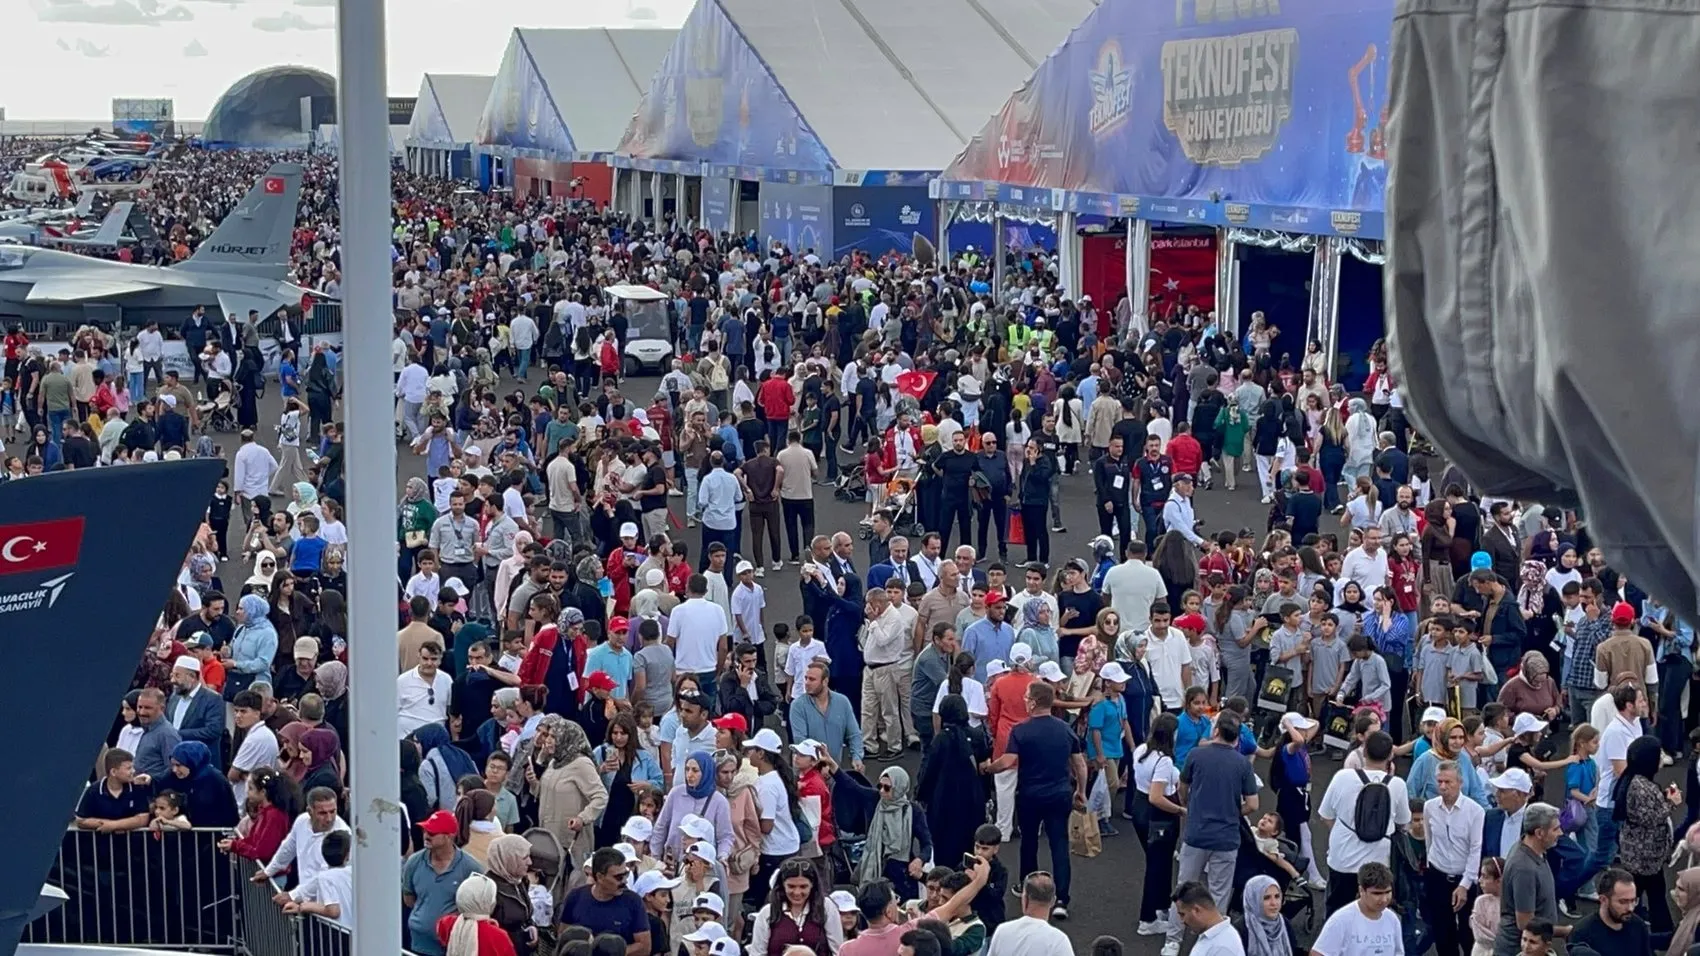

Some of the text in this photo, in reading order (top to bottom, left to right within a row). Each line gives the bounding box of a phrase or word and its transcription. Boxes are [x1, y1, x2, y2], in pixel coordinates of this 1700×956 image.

[1163, 32, 1294, 102] TEKNOFEST
[1186, 98, 1273, 142] GÜNEYDOĞU
[210, 243, 268, 255] HÜRJET
[0, 589, 48, 604] VACILIK
